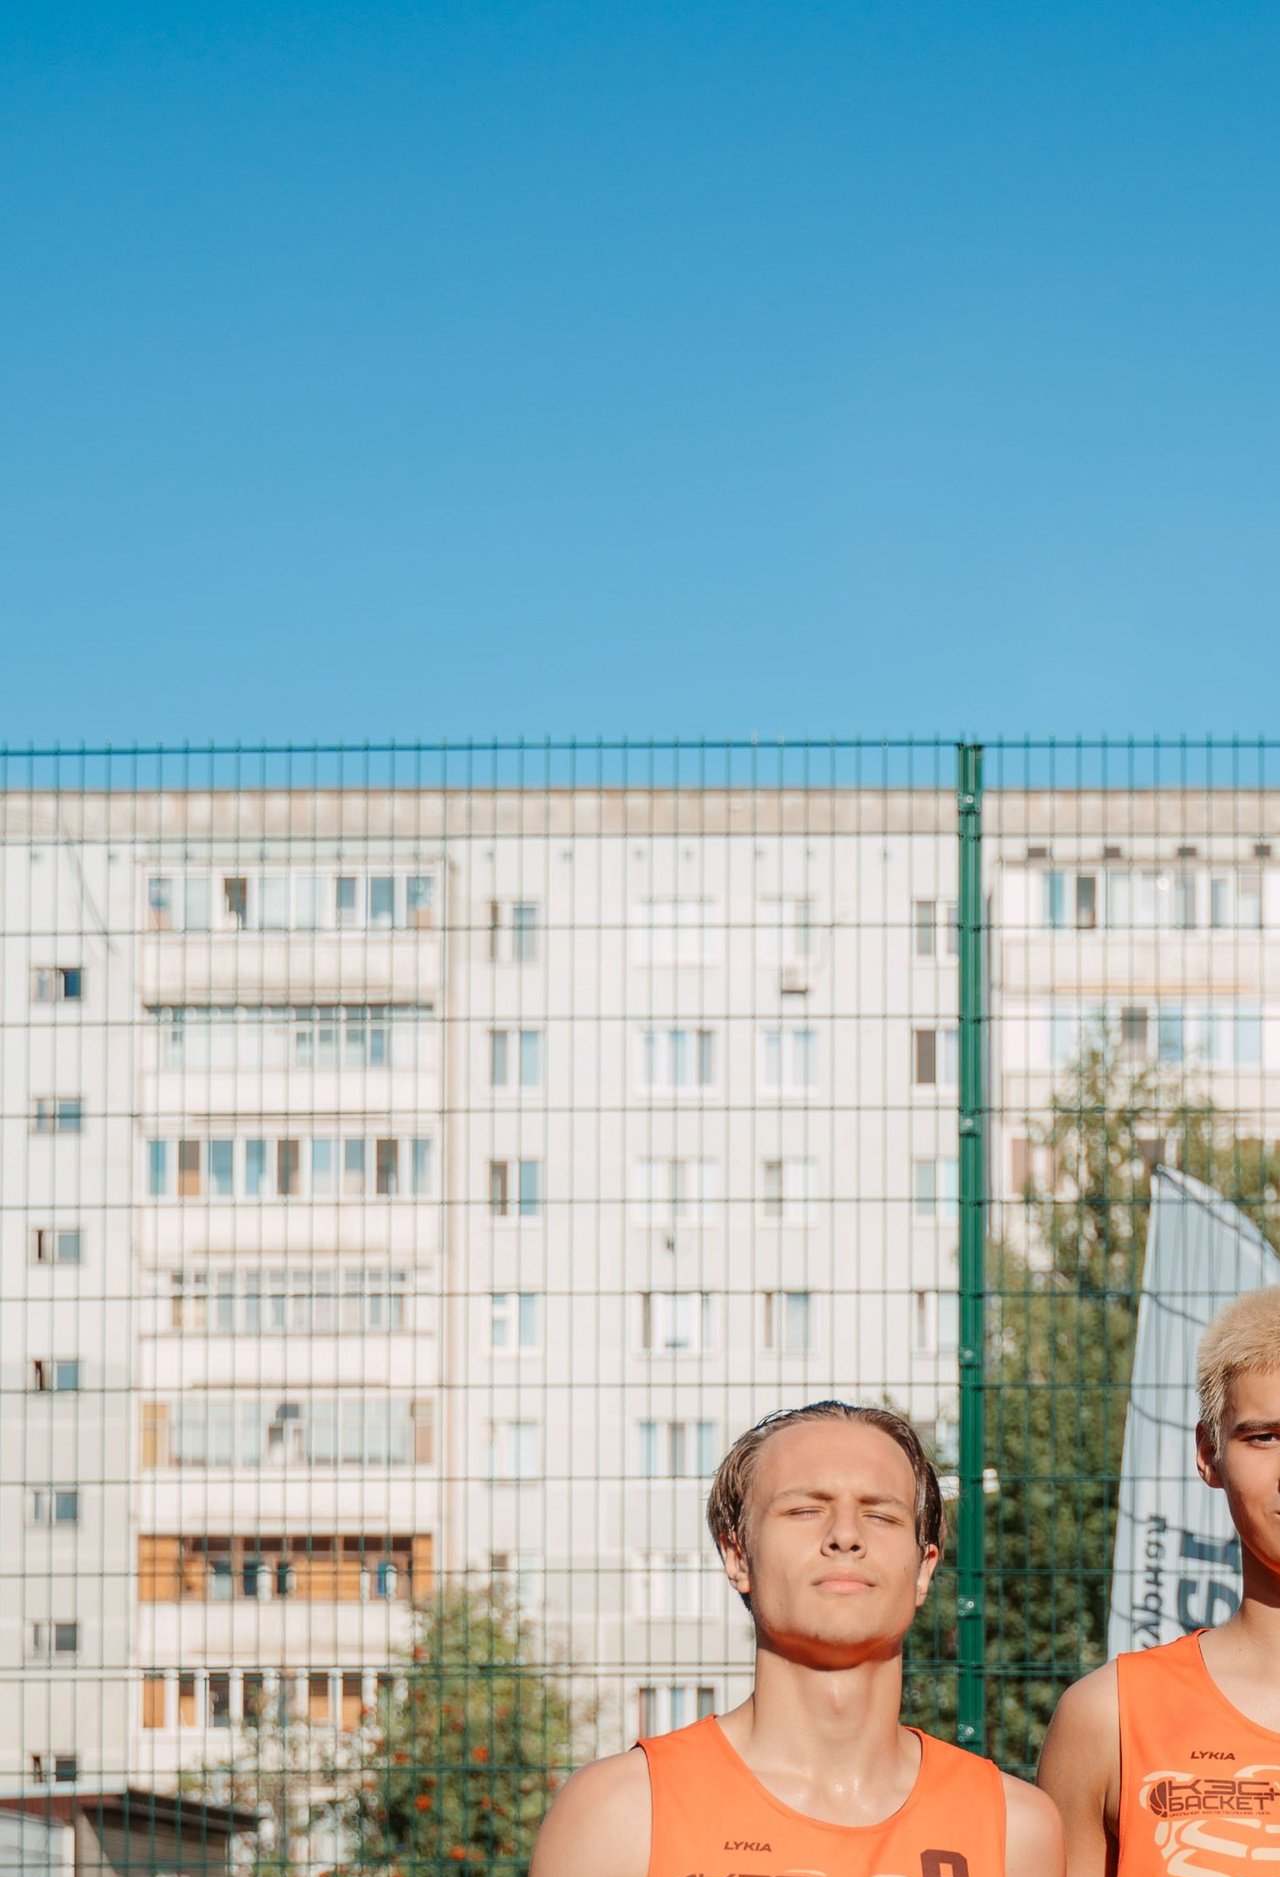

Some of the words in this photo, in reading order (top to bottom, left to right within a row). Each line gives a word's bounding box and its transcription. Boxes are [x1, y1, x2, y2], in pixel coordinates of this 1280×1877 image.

[1190, 1750, 1236, 1761] LYKIA
[1168, 1795, 1270, 1813] БАСКЕТ
[723, 1841, 773, 1853] LYKIA
